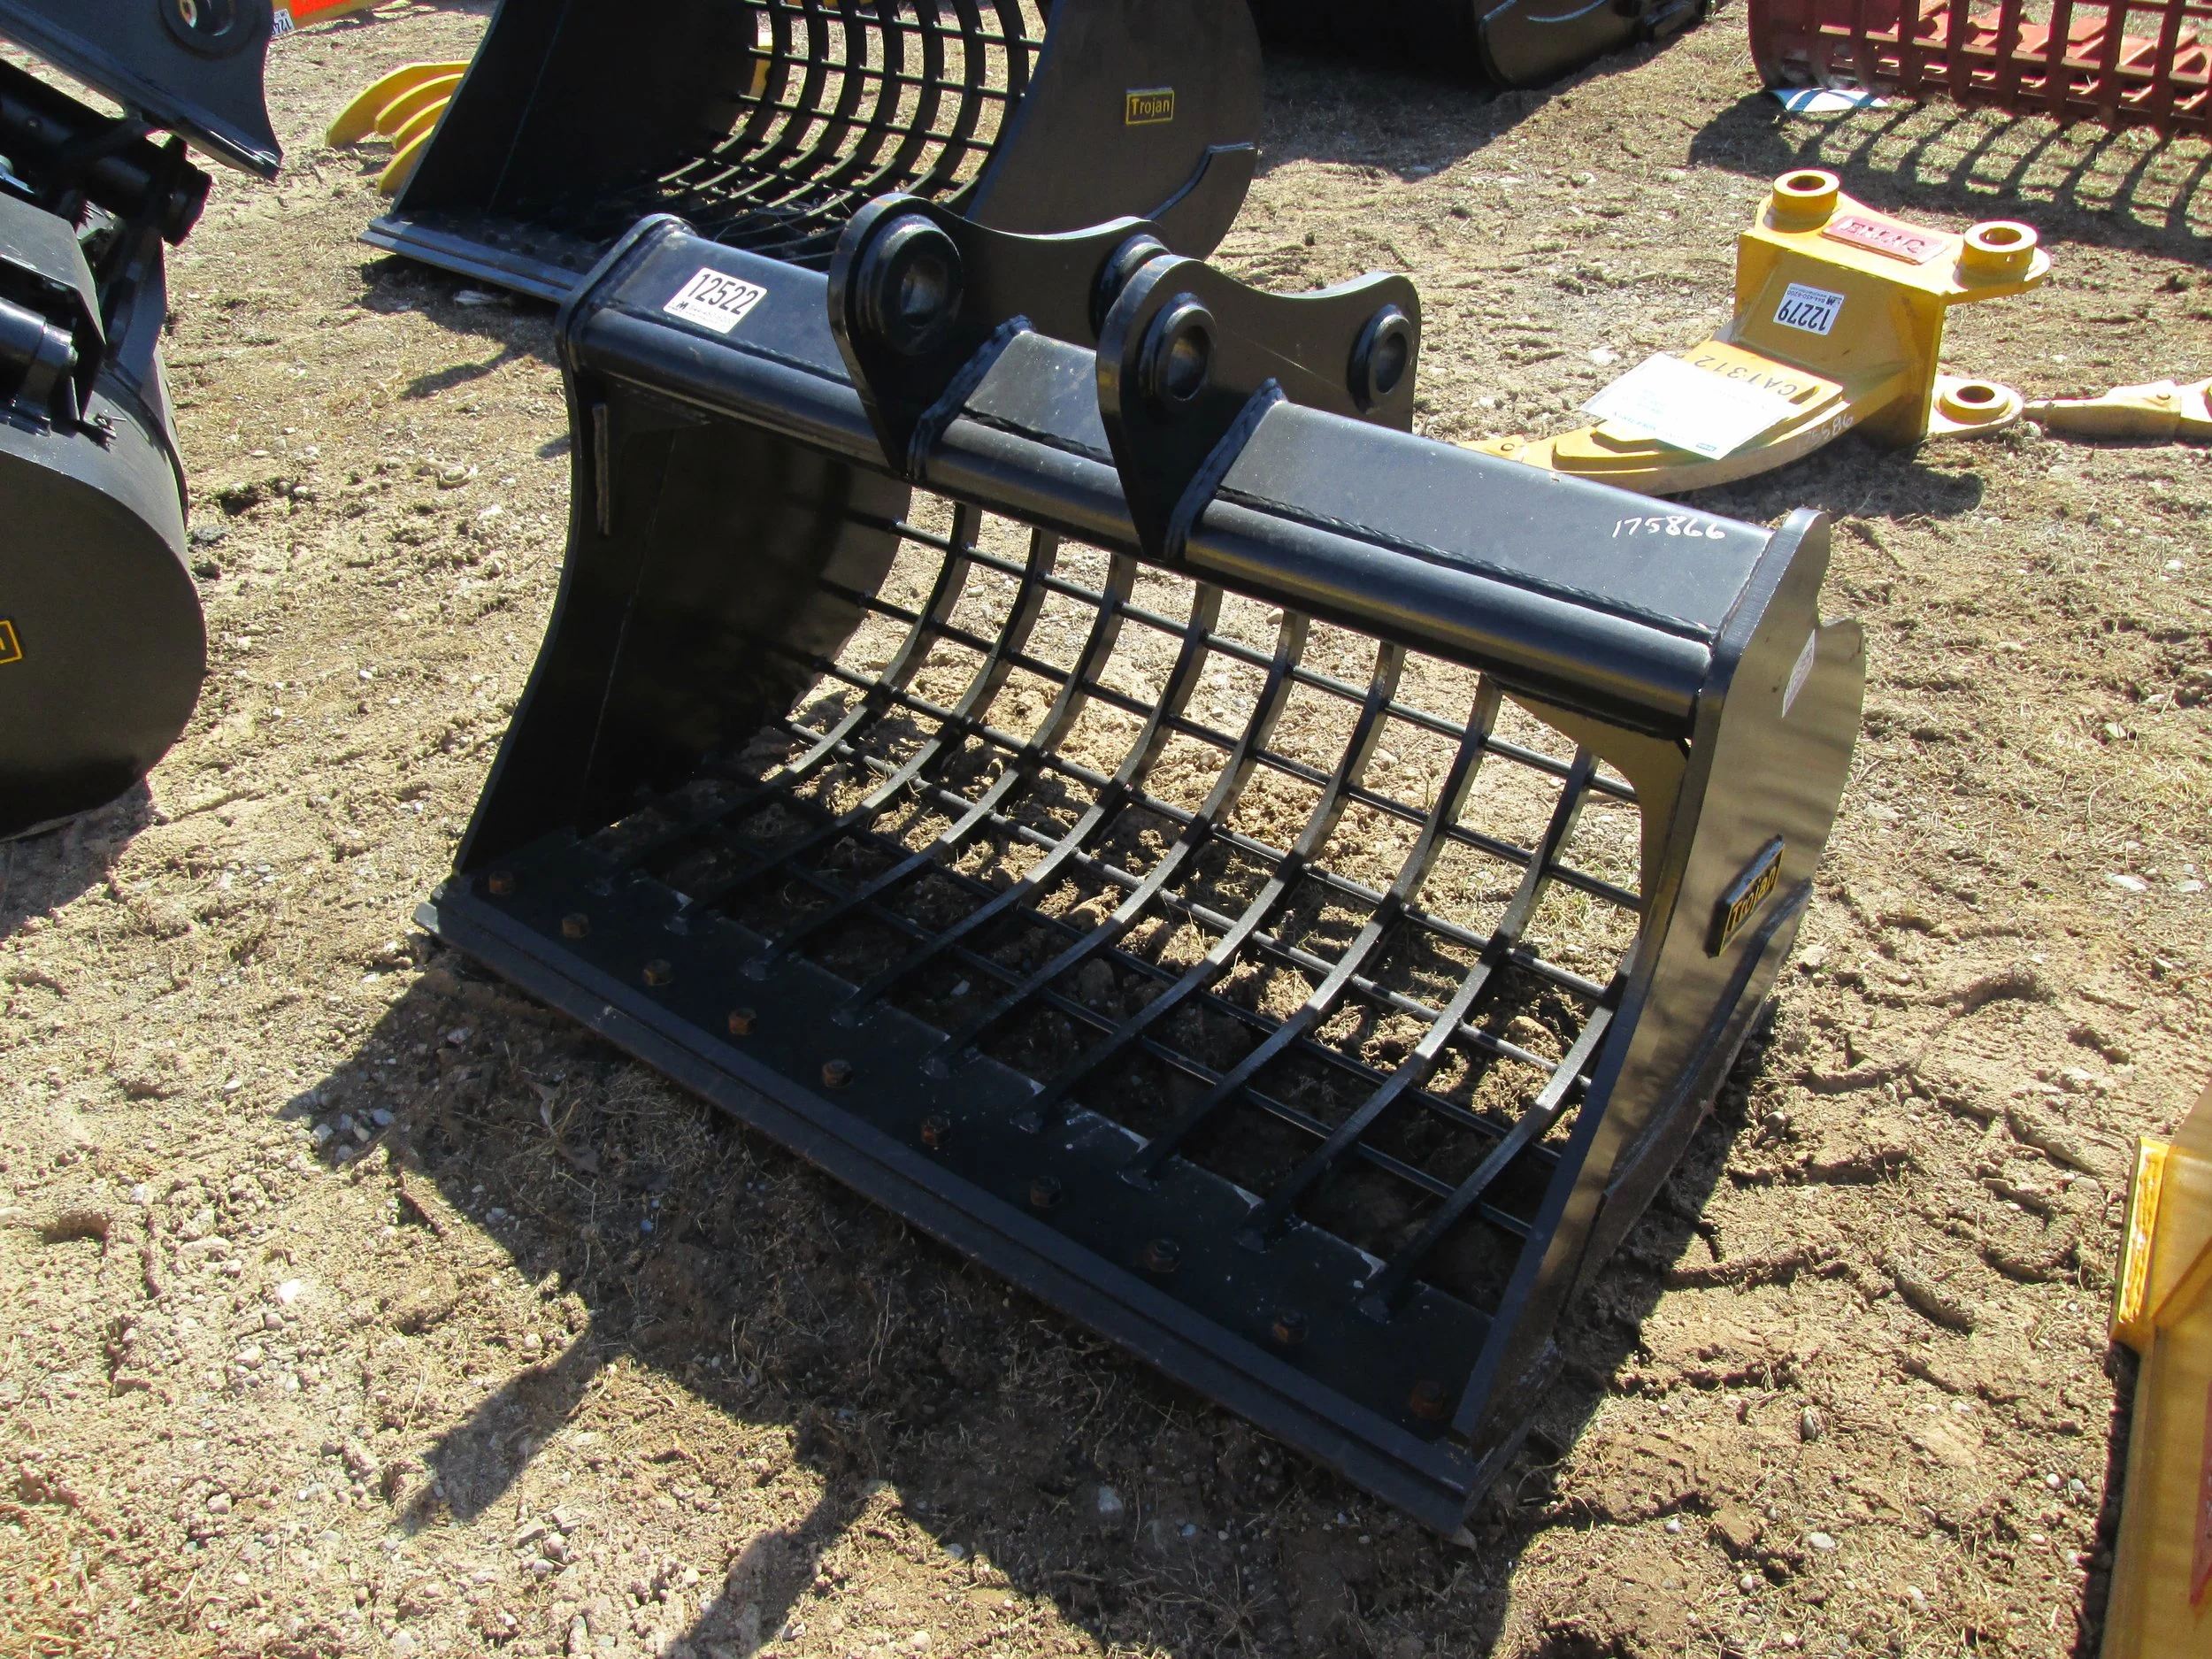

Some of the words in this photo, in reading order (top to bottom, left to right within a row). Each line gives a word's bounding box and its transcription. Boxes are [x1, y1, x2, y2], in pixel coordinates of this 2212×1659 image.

[1132, 97, 1170, 118] Trojan
[687, 273, 759, 315] 12522
[1778, 299, 1831, 331] 12279
[1612, 515, 1726, 540] 175866
[1732, 864, 1777, 932] Trojan
